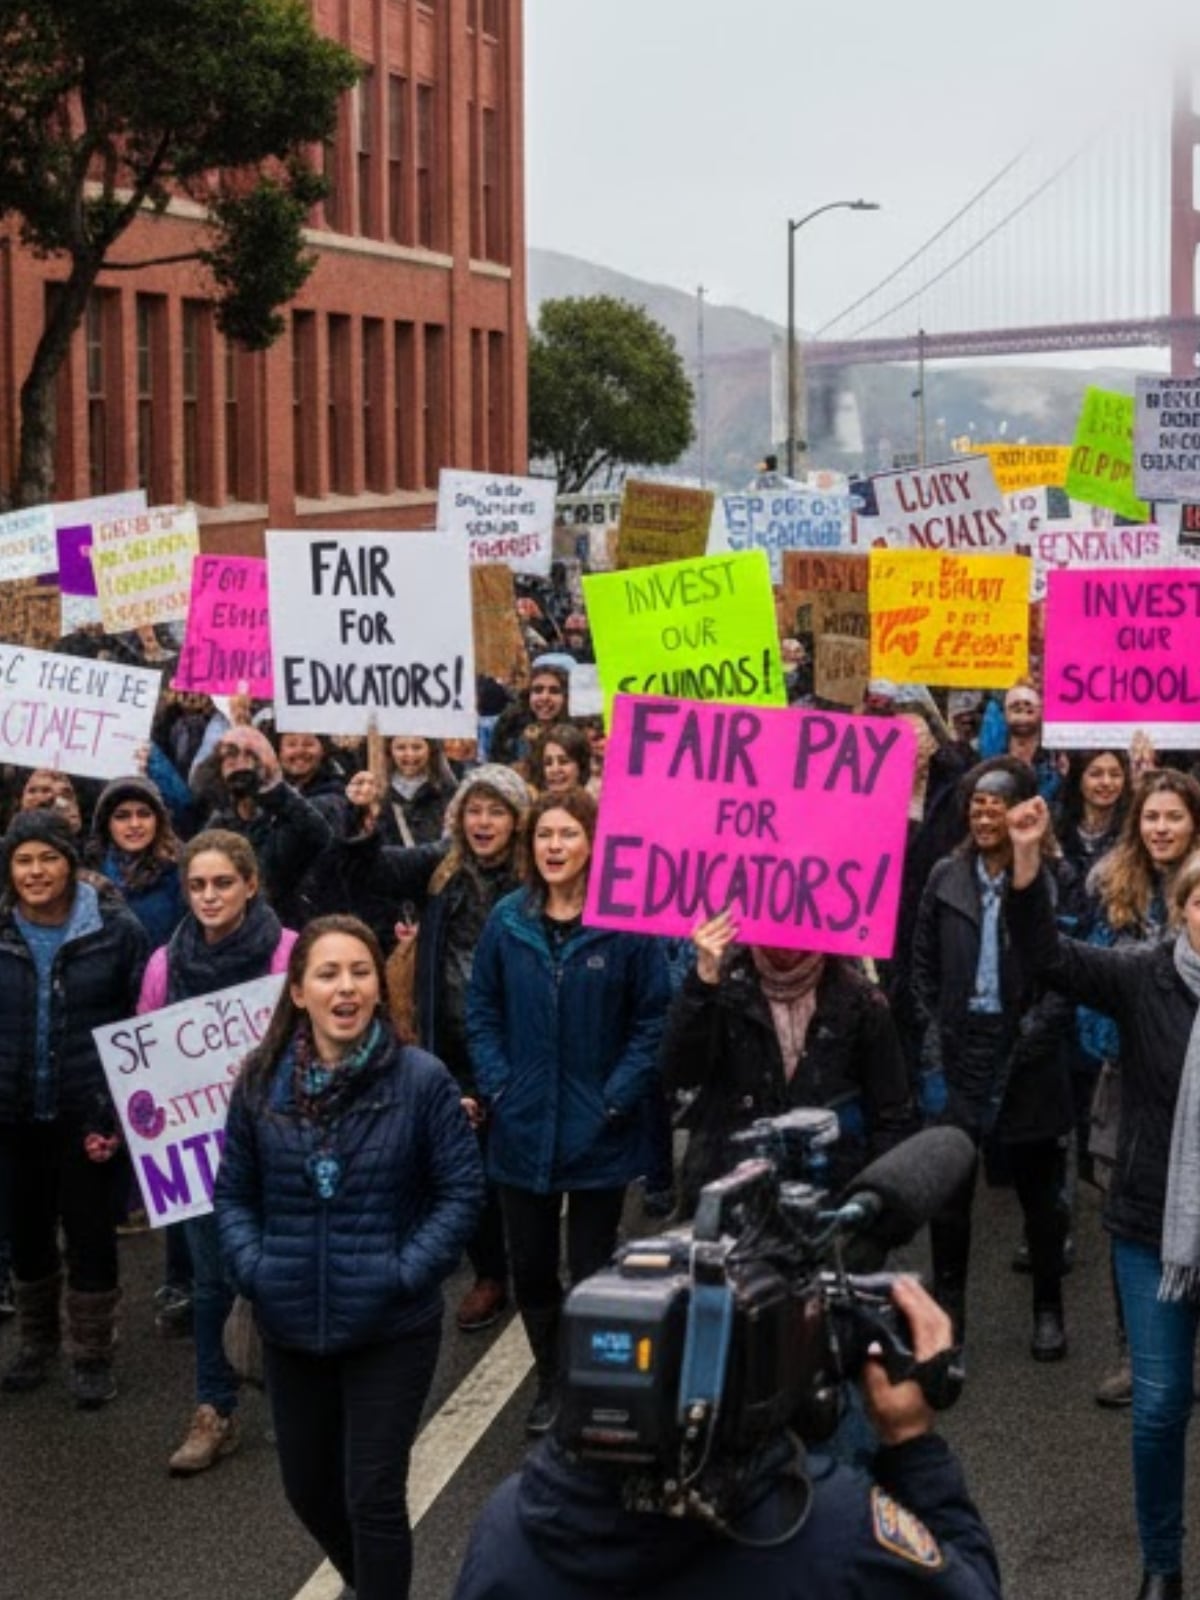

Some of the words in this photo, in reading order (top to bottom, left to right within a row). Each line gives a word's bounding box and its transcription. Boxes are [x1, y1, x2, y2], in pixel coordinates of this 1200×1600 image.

[309, 541, 395, 598] FAIR
[624, 560, 735, 616] INVEST
[339, 608, 395, 645] FOR
[660, 616, 718, 651] OUR
[627, 702, 762, 788] FAIR
[793, 715, 901, 796] PAY
[714, 798, 779, 843] FOR
[596, 834, 892, 941] EDUCATORS!
[109, 1022, 158, 1076] SF
